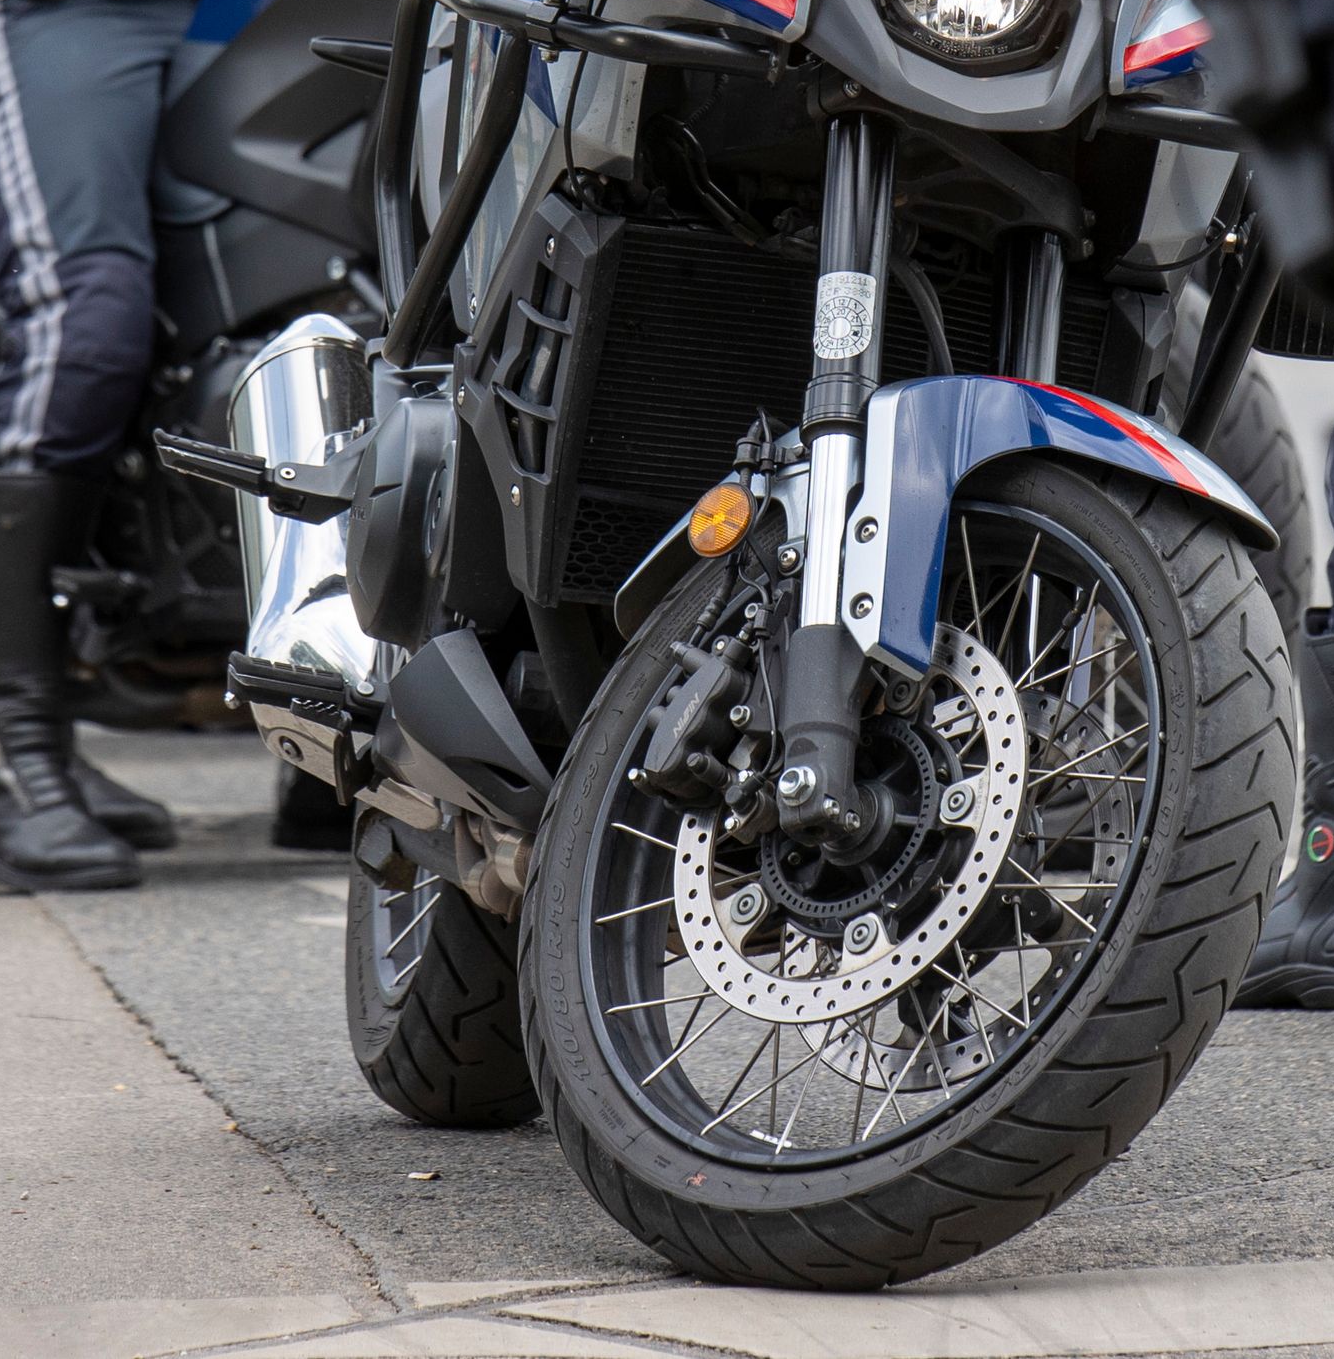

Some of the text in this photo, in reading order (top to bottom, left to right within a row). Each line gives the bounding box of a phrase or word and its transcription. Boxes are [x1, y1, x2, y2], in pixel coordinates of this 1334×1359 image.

[1073, 719, 1187, 1014] SCORPION
[548, 968, 593, 1081] 110/80
[935, 1023, 1069, 1145] TRAIL
